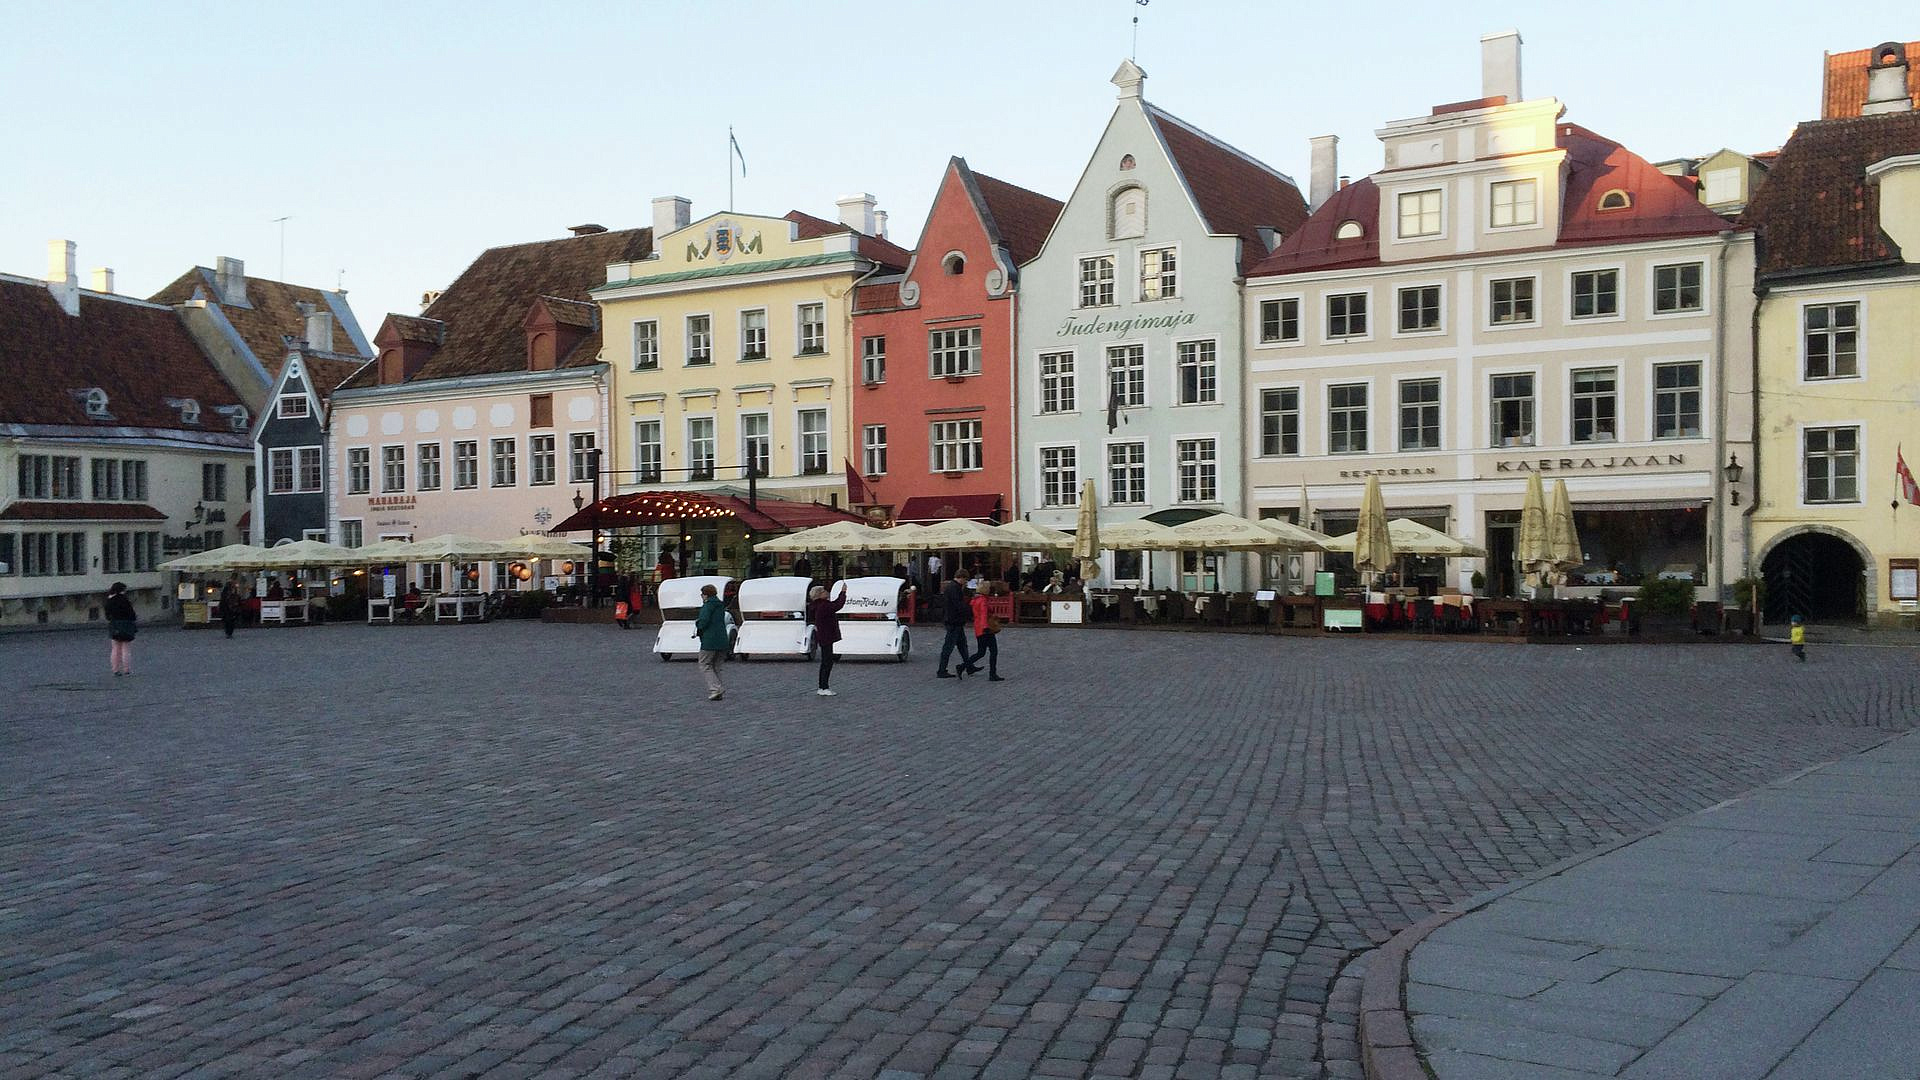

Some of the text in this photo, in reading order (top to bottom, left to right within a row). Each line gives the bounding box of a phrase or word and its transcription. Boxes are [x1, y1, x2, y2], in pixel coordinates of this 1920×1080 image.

[1057, 310, 1196, 339] Tudengimaja
[1340, 467, 1435, 478] RESTORAN
[1496, 454, 1684, 473] KAERAJAAN
